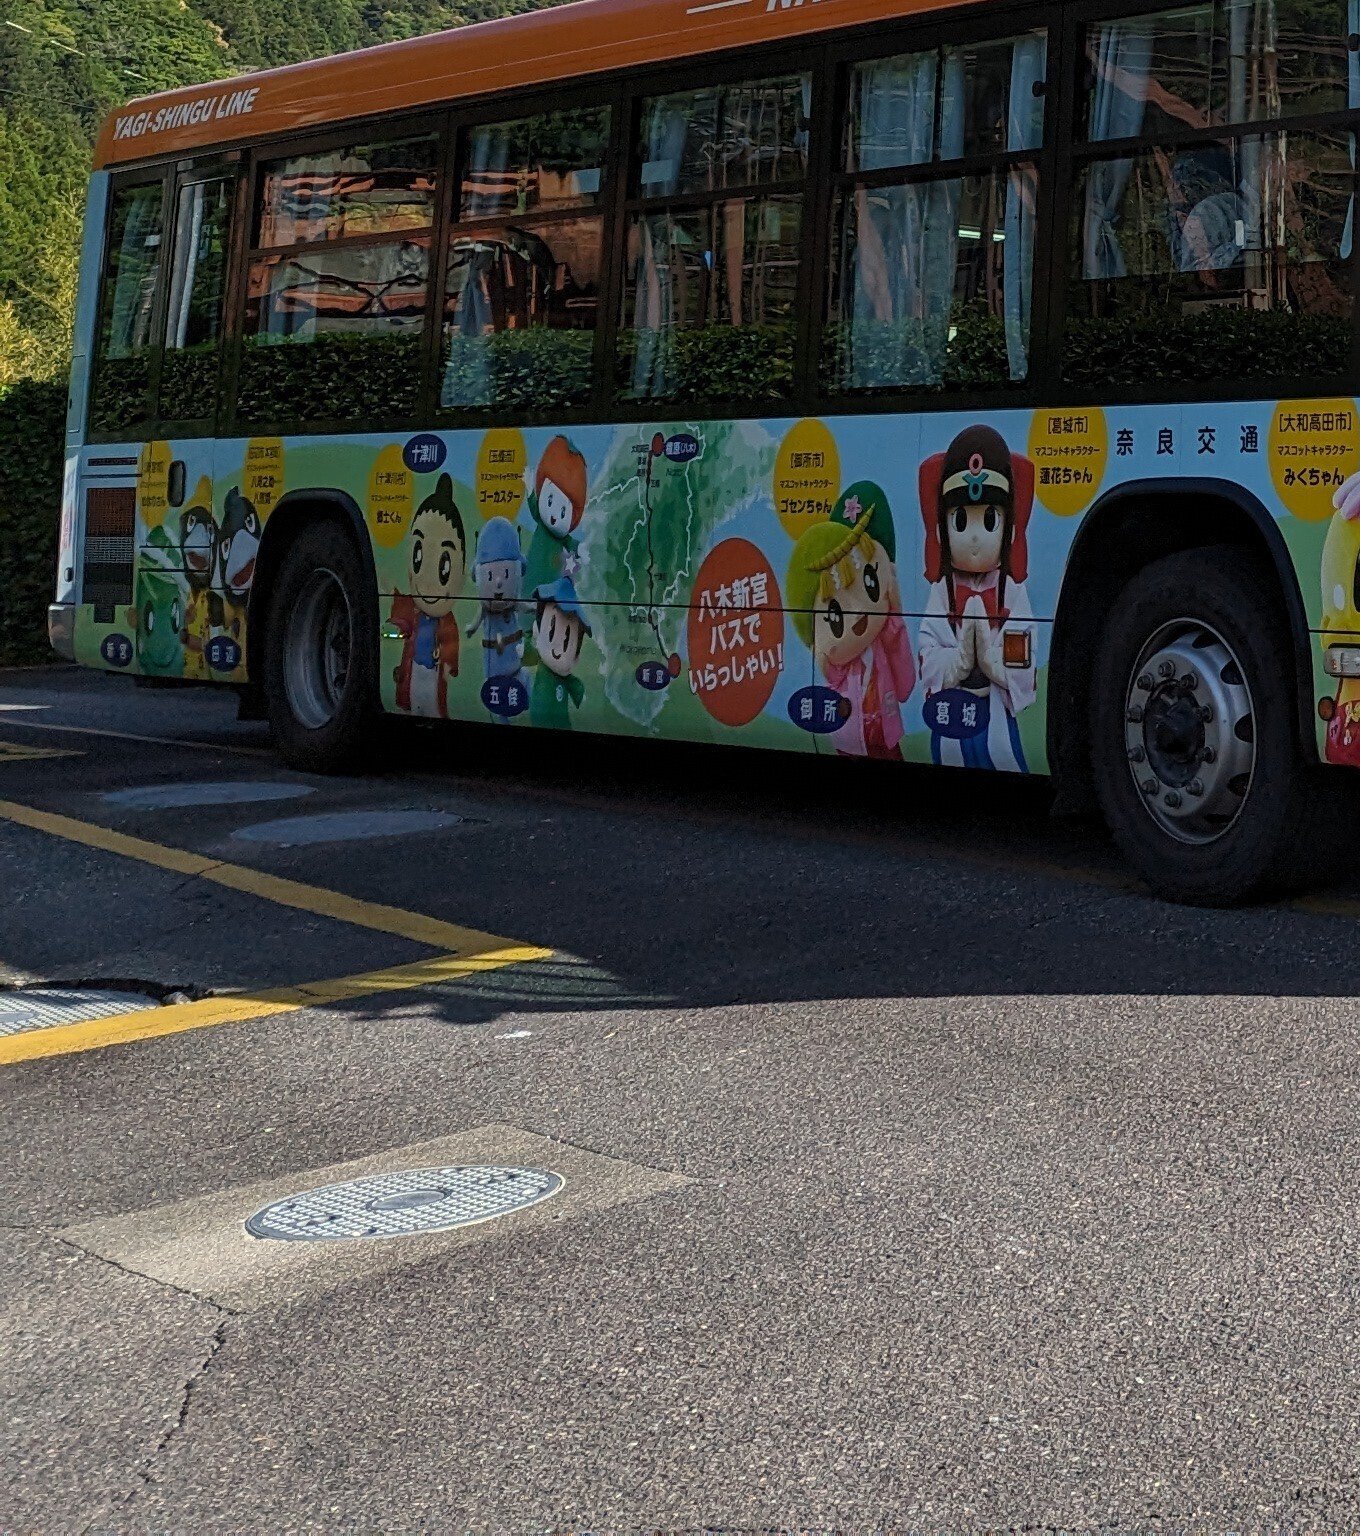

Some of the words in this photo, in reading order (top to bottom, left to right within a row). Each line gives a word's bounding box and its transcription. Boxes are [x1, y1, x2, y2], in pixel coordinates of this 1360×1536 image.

[113, 97, 217, 140] YAGI-SHINGU
[215, 88, 260, 119] LINE
[1279, 412, 1352, 432] [大和高田市]
[1116, 425, 1259, 456] 奈良交通
[1277, 444, 1354, 456] マスコットキャラクター
[412, 444, 438, 464] 十津川
[1034, 445, 1101, 457] マスコットキャラクター
[1039, 467, 1093, 485] 蓮花ちゃん
[1284, 468, 1345, 486] みくちゃん
[480, 490, 521, 503] ゴーカスター
[780, 497, 832, 515] ゴセンちゃん
[698, 572, 768, 622] 八木新宮
[709, 613, 761, 654] バスで
[800, 698, 837, 723] 御所
[936, 701, 977, 728] 葛城
